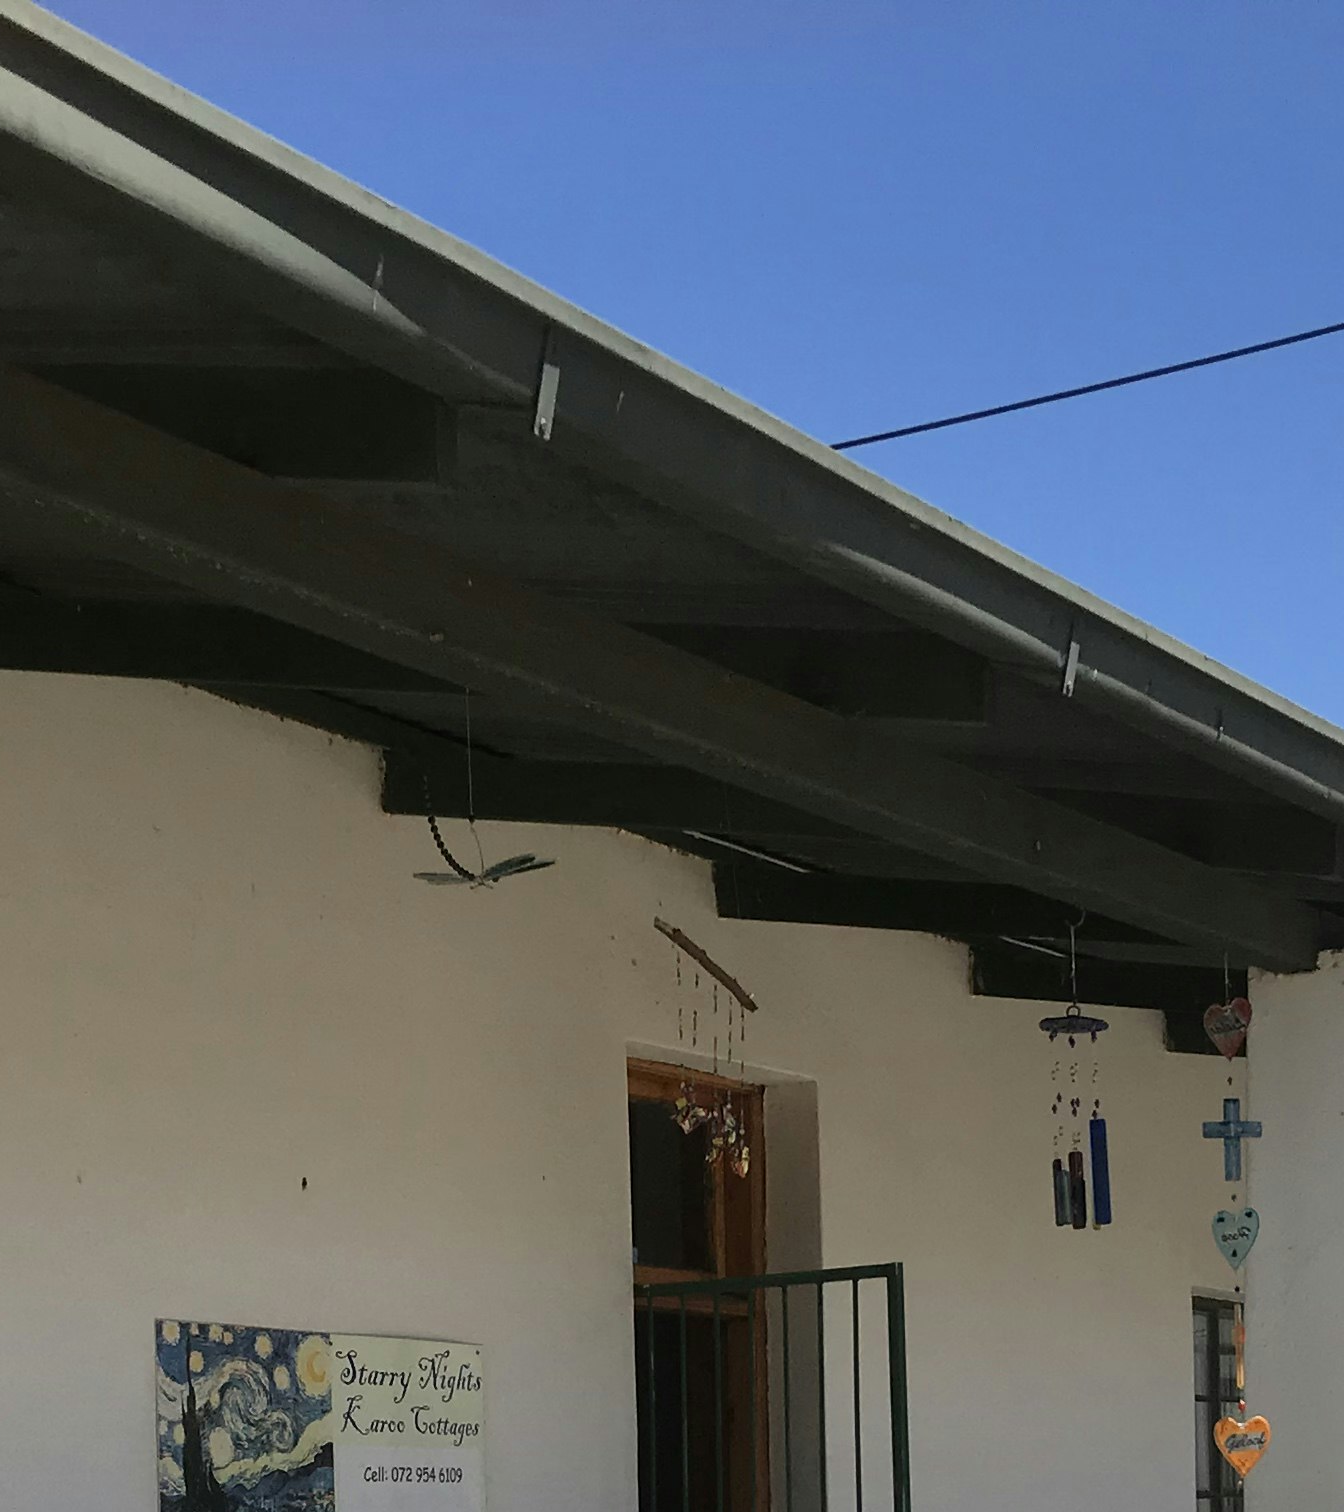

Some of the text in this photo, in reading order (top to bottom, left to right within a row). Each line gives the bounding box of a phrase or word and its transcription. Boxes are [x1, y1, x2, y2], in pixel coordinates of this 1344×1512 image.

[336, 1350, 482, 1403] Starry Nights
[341, 1395, 480, 1446] Karoo Cottages
[363, 1466, 463, 1483] Cell: 072 954 6109
